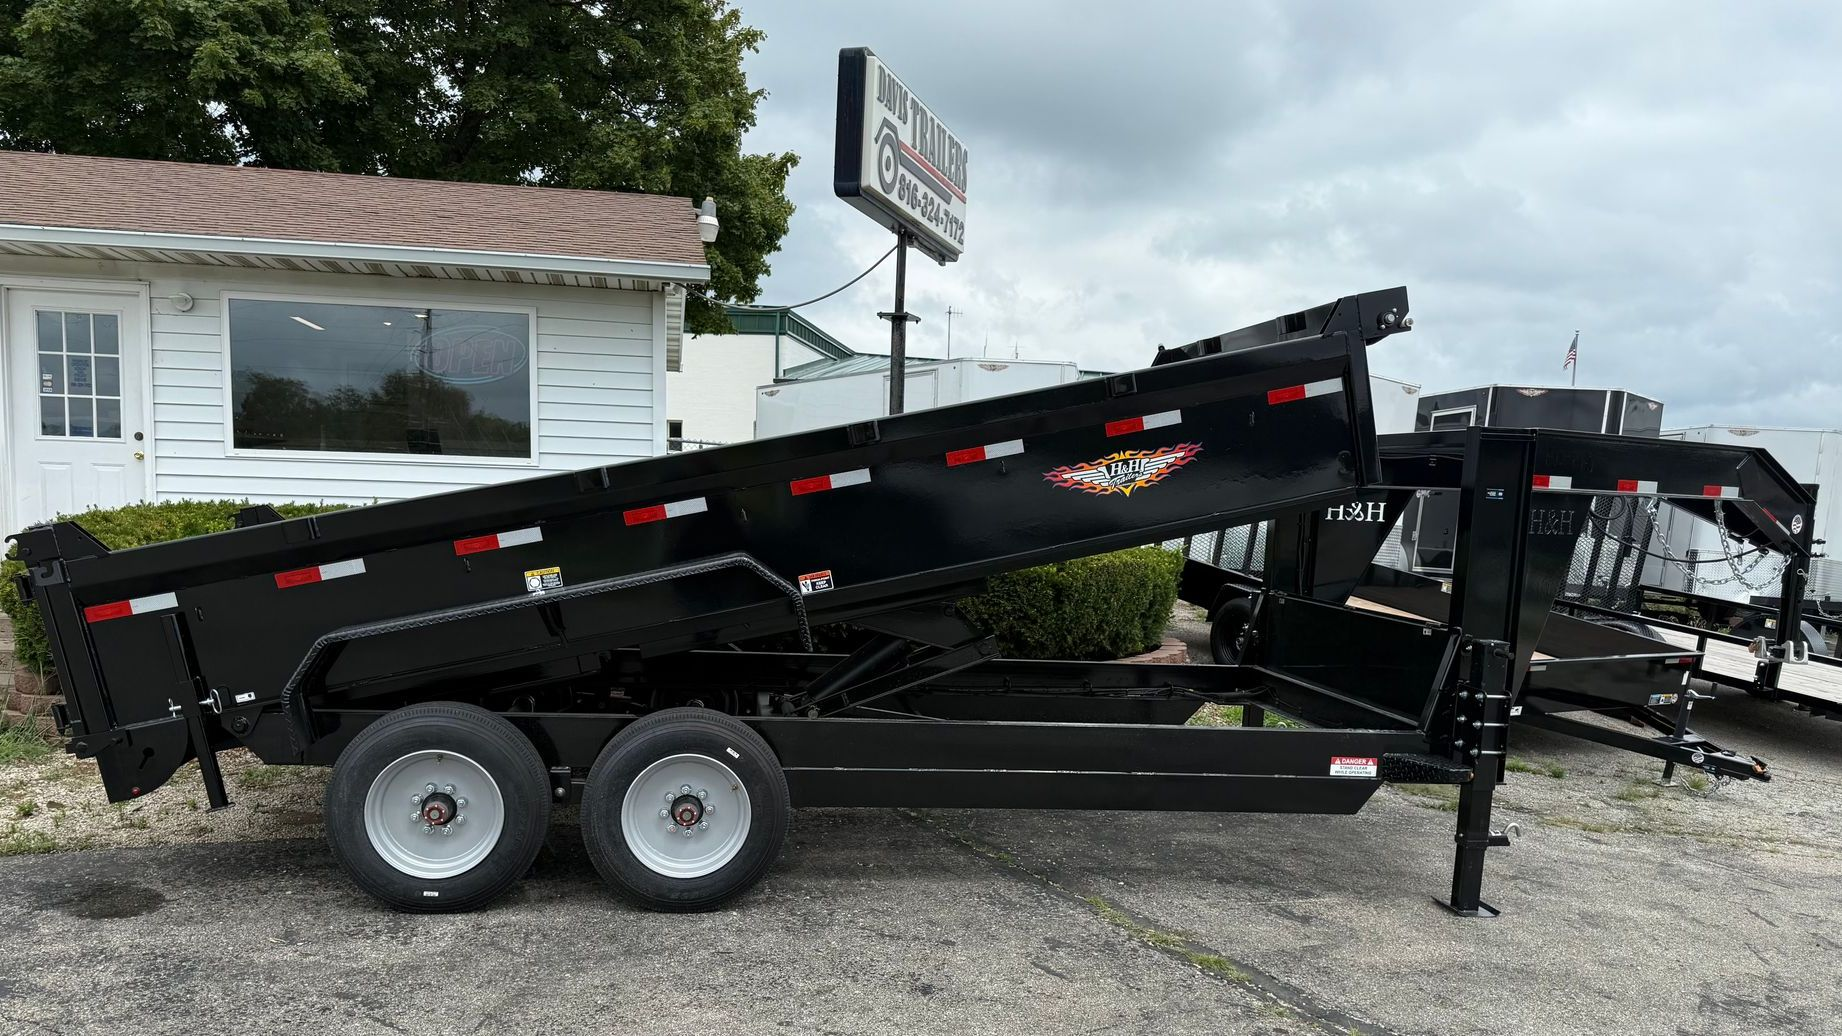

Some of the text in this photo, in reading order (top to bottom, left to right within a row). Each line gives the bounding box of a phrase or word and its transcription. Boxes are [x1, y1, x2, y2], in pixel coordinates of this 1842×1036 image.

[877, 64, 969, 194] DAVIS TRAILERS
[897, 172, 965, 246] 816-324-7172
[423, 337, 515, 376] OPEN
[1108, 472, 1143, 490] Trailers
[1110, 459, 1142, 477] H&H
[1324, 501, 1387, 523] H&H
[1528, 509, 1576, 535] H&H
